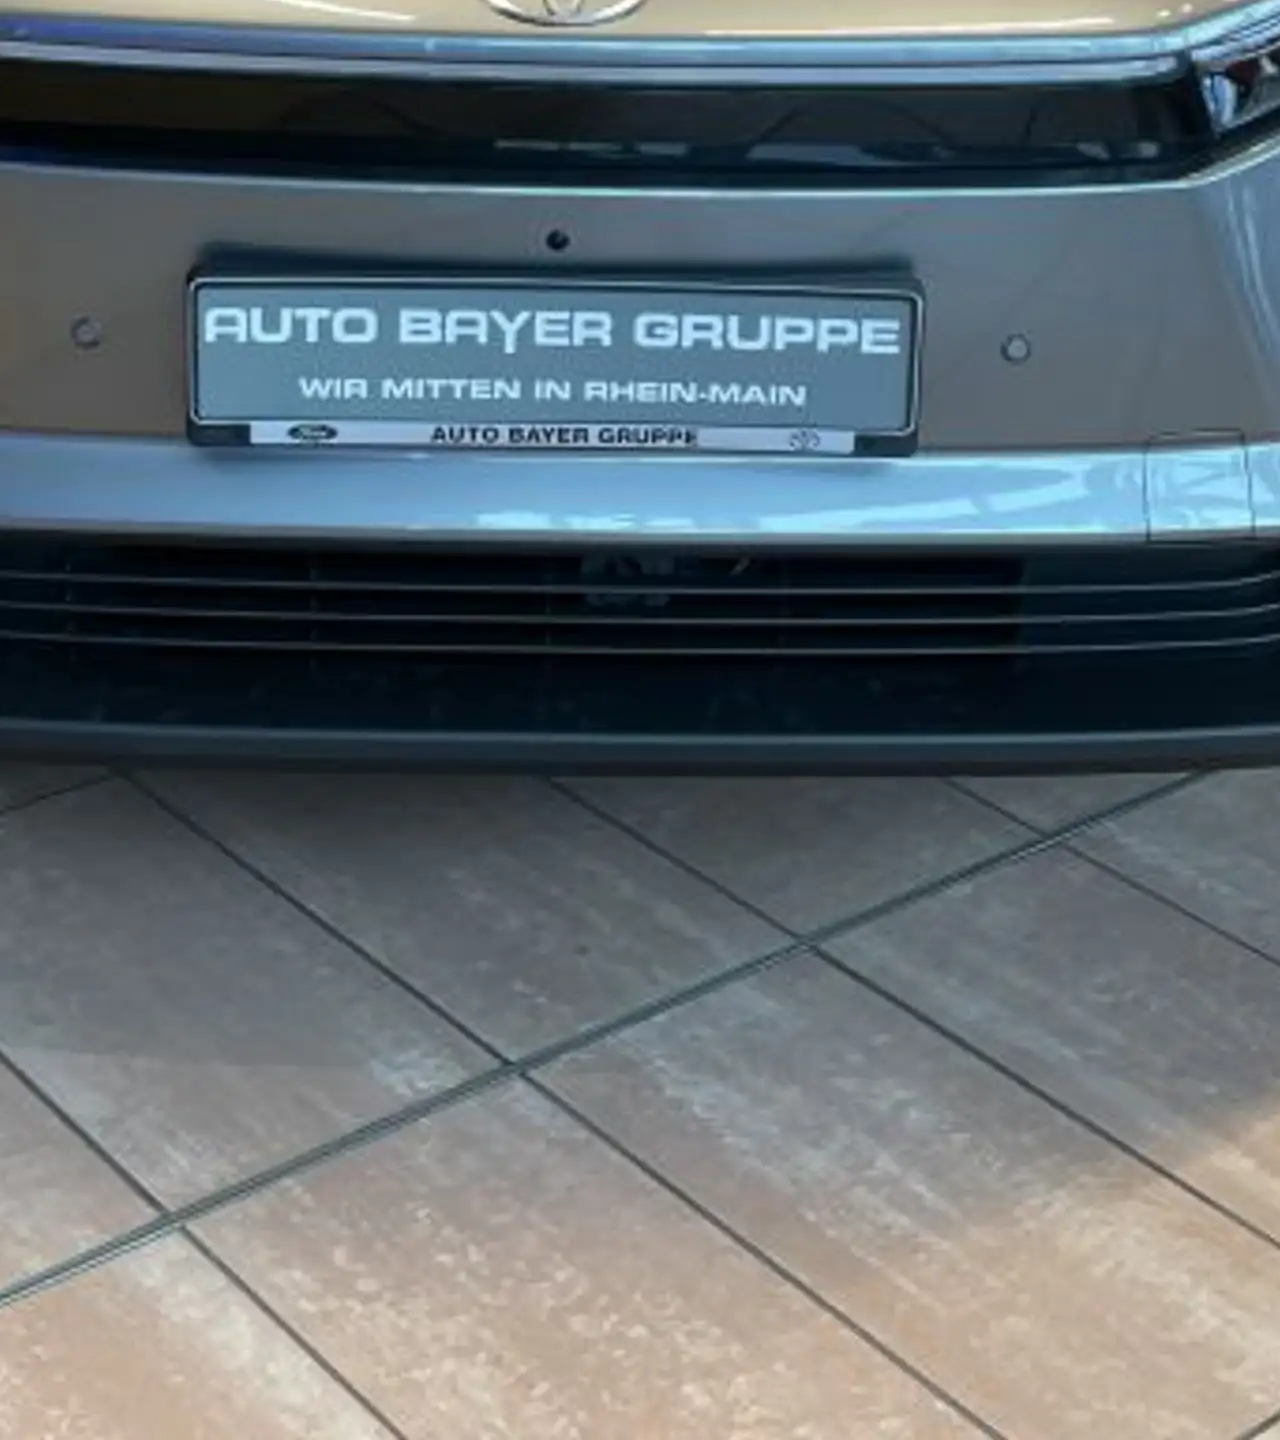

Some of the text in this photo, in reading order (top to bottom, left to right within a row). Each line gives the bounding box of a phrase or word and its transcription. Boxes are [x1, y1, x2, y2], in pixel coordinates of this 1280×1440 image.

[204, 306, 901, 355] AUTO BAYER GRUPPE
[297, 376, 807, 407] WIR MITTEN IN RHEIN-MAIN
[430, 426, 699, 447] AUTO BAYER GRUPPE
